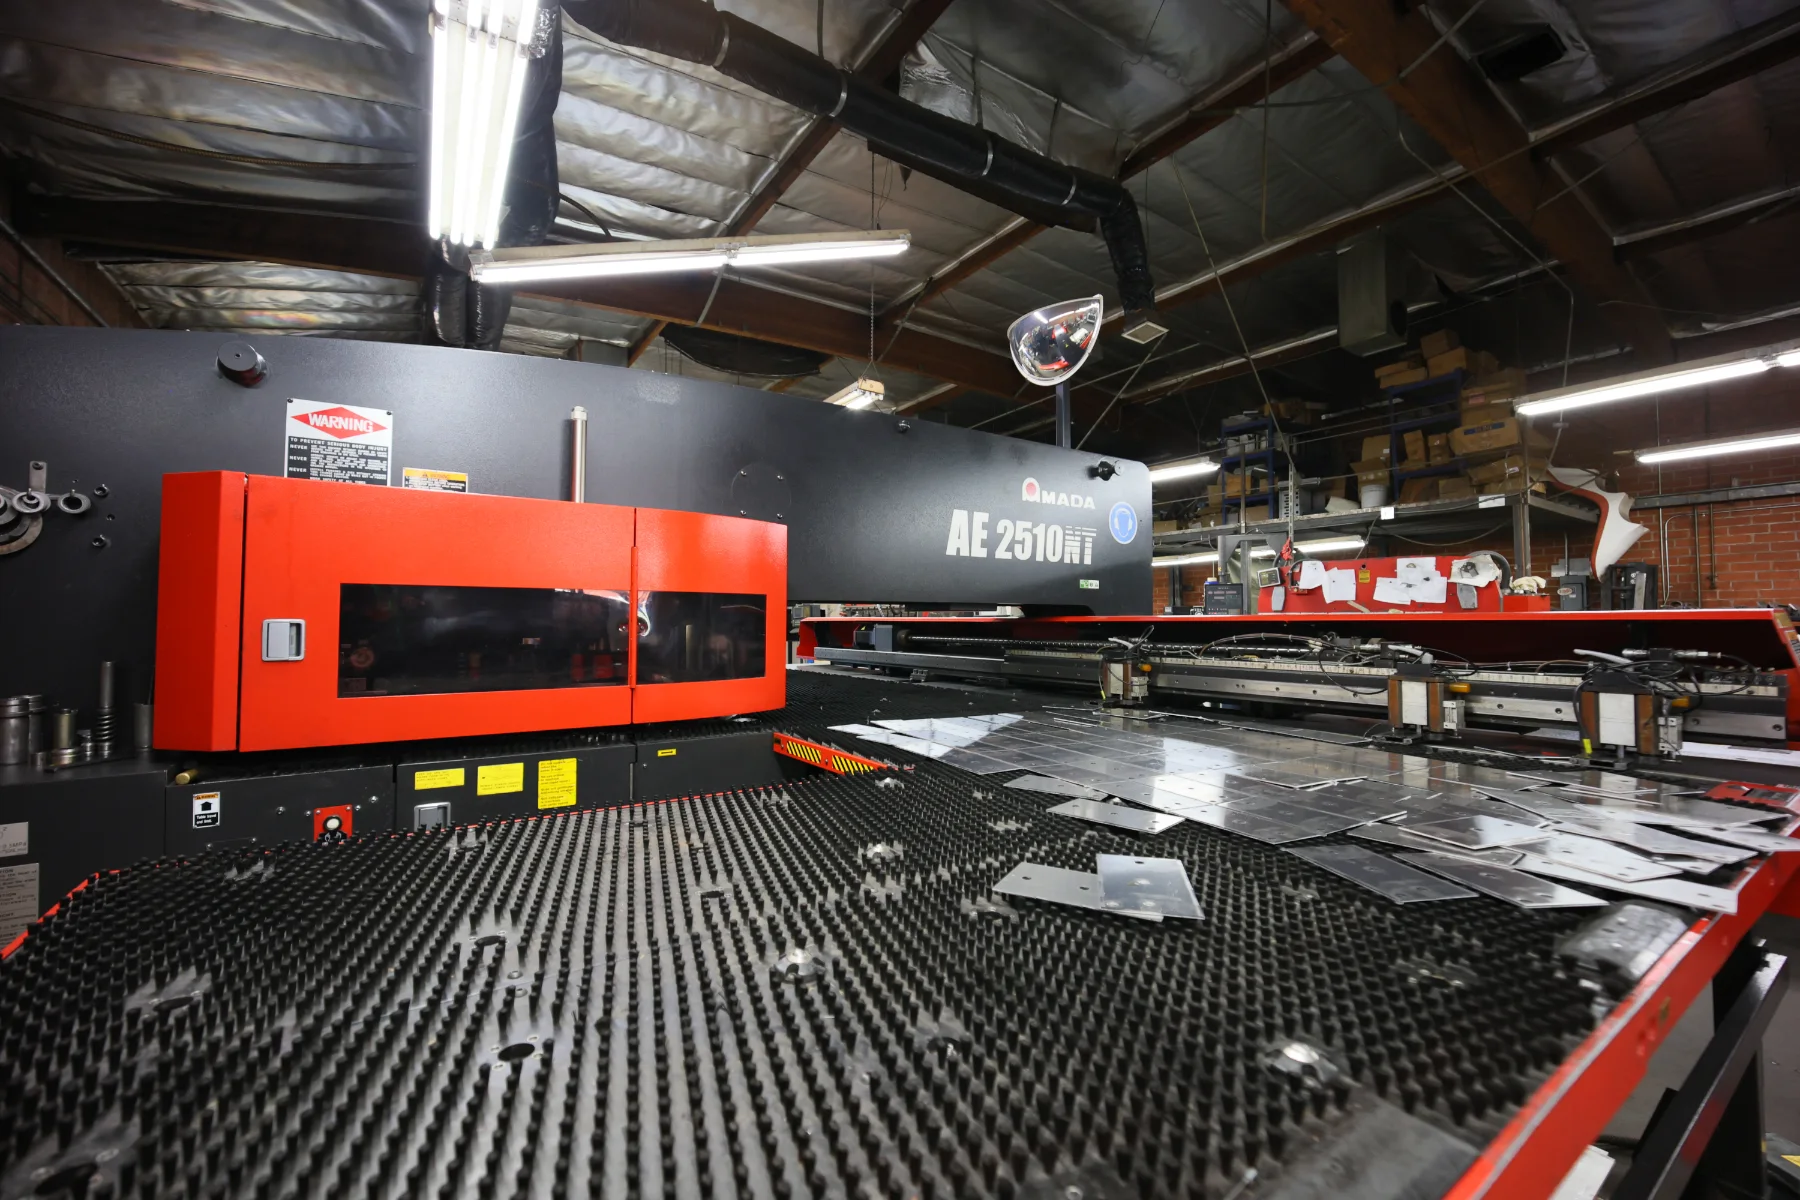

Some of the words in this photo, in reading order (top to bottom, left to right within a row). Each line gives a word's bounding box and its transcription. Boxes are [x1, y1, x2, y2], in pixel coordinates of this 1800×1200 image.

[307, 413, 374, 433] WARNING
[1022, 477, 1096, 510] AMADA
[945, 508, 990, 558] AE
